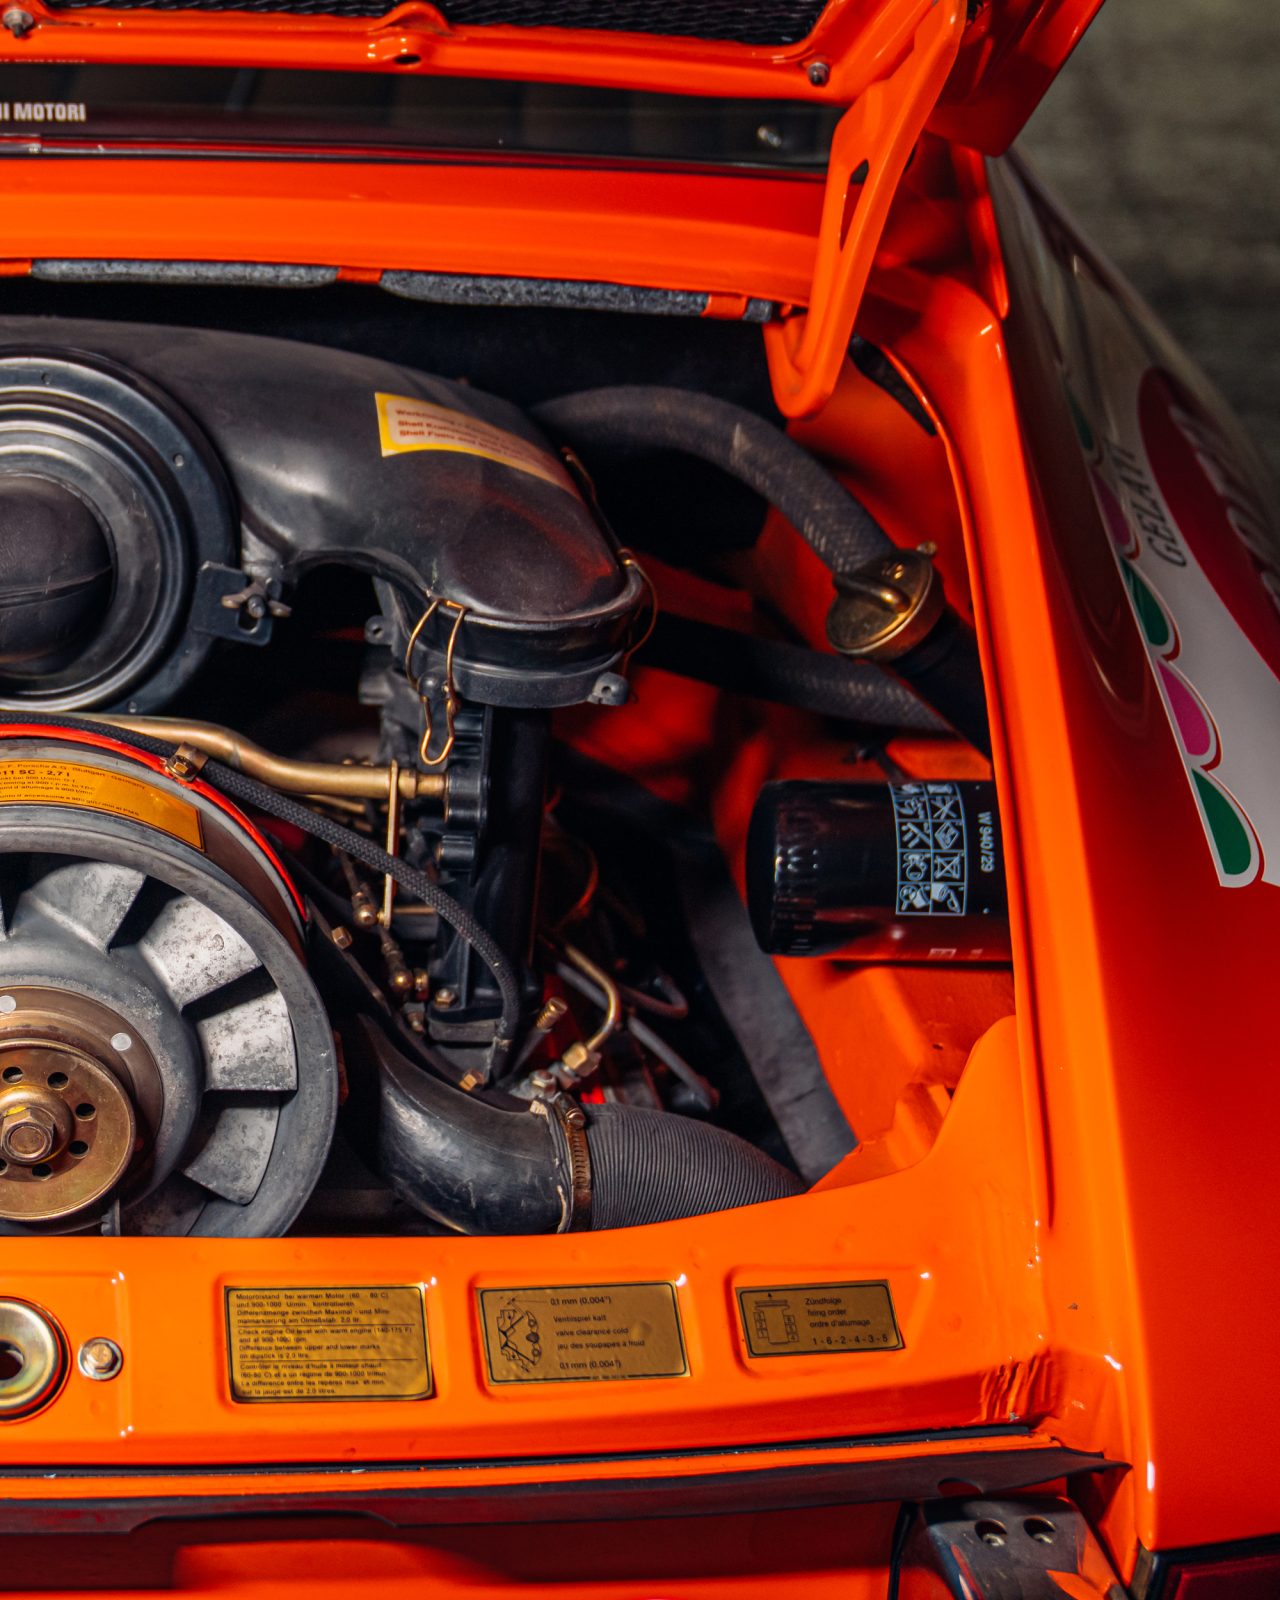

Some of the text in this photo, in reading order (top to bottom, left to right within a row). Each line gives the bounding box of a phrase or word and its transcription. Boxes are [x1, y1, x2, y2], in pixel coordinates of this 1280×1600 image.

[13, 102, 86, 122] MOTORI
[1105, 440, 1187, 568] GELATI
[978, 811, 995, 873] W 940/29
[827, 1308, 847, 1316] order
